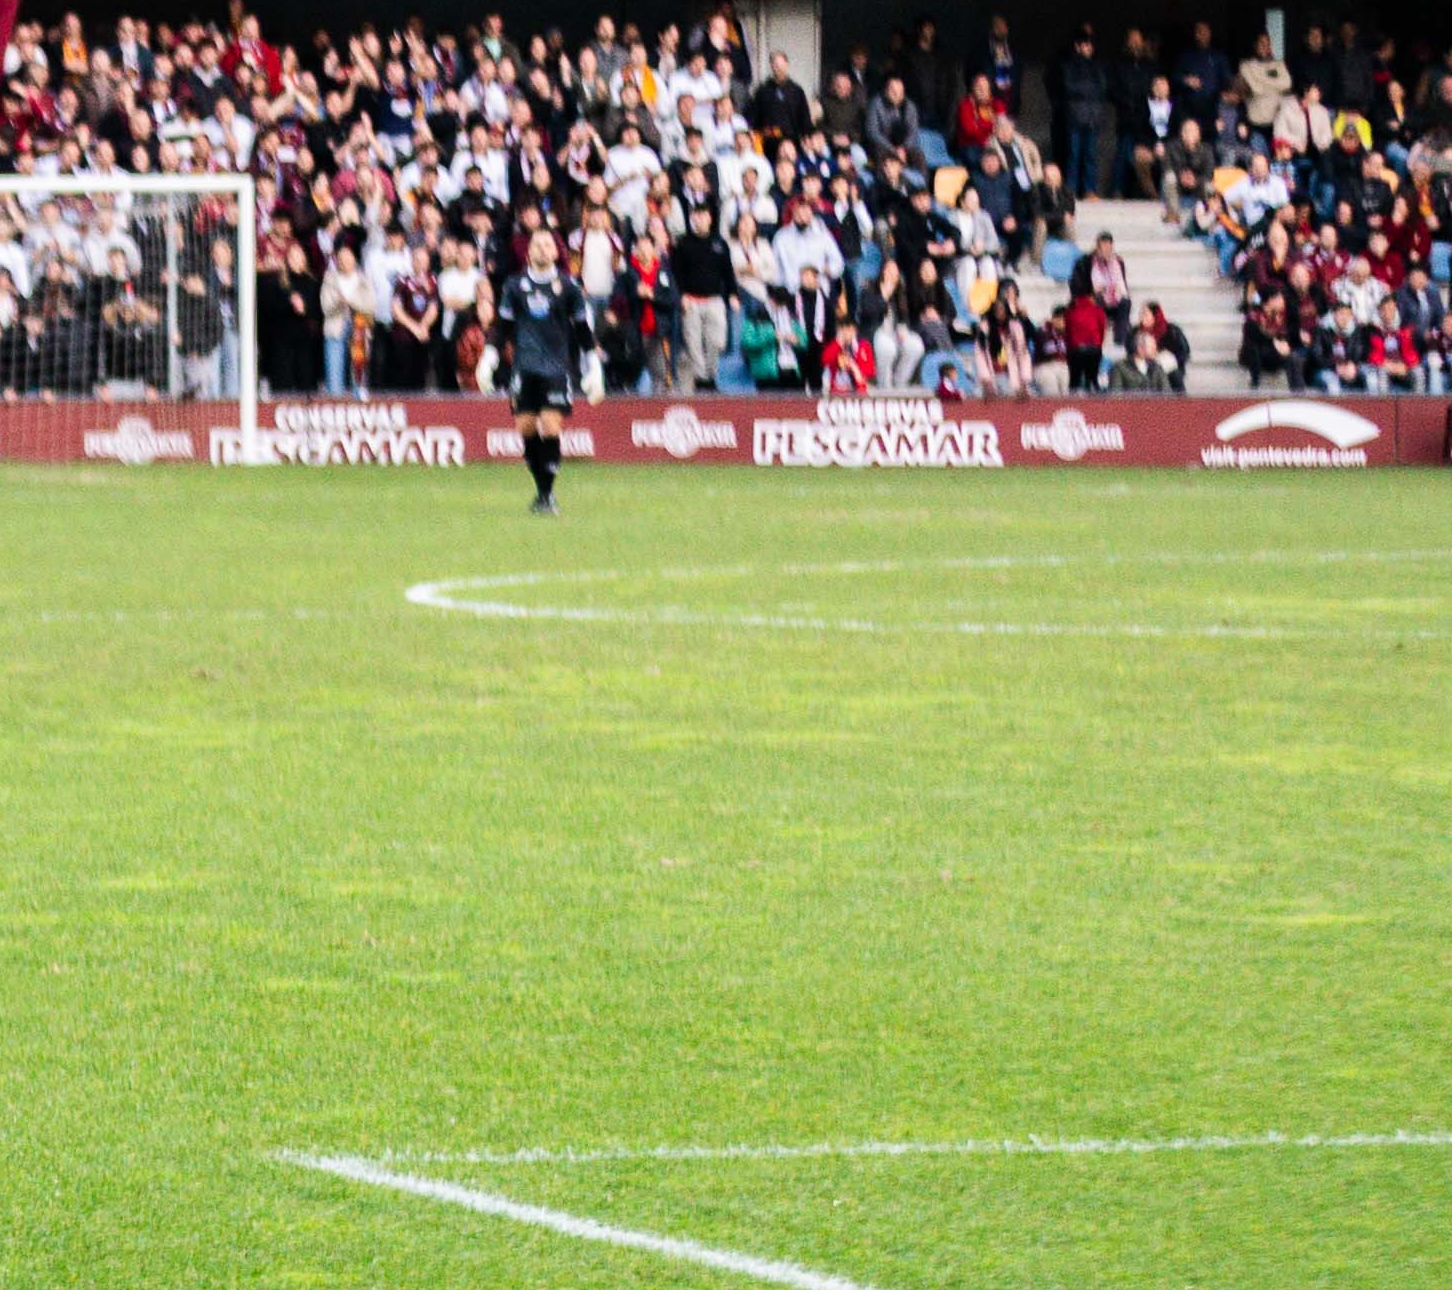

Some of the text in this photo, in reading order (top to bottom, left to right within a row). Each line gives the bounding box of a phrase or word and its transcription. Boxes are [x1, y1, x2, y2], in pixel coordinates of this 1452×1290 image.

[275, 405, 407, 431] CONSERVAS
[817, 399, 944, 424] CONSERVAS
[753, 419, 1004, 467] PESCAMAR
